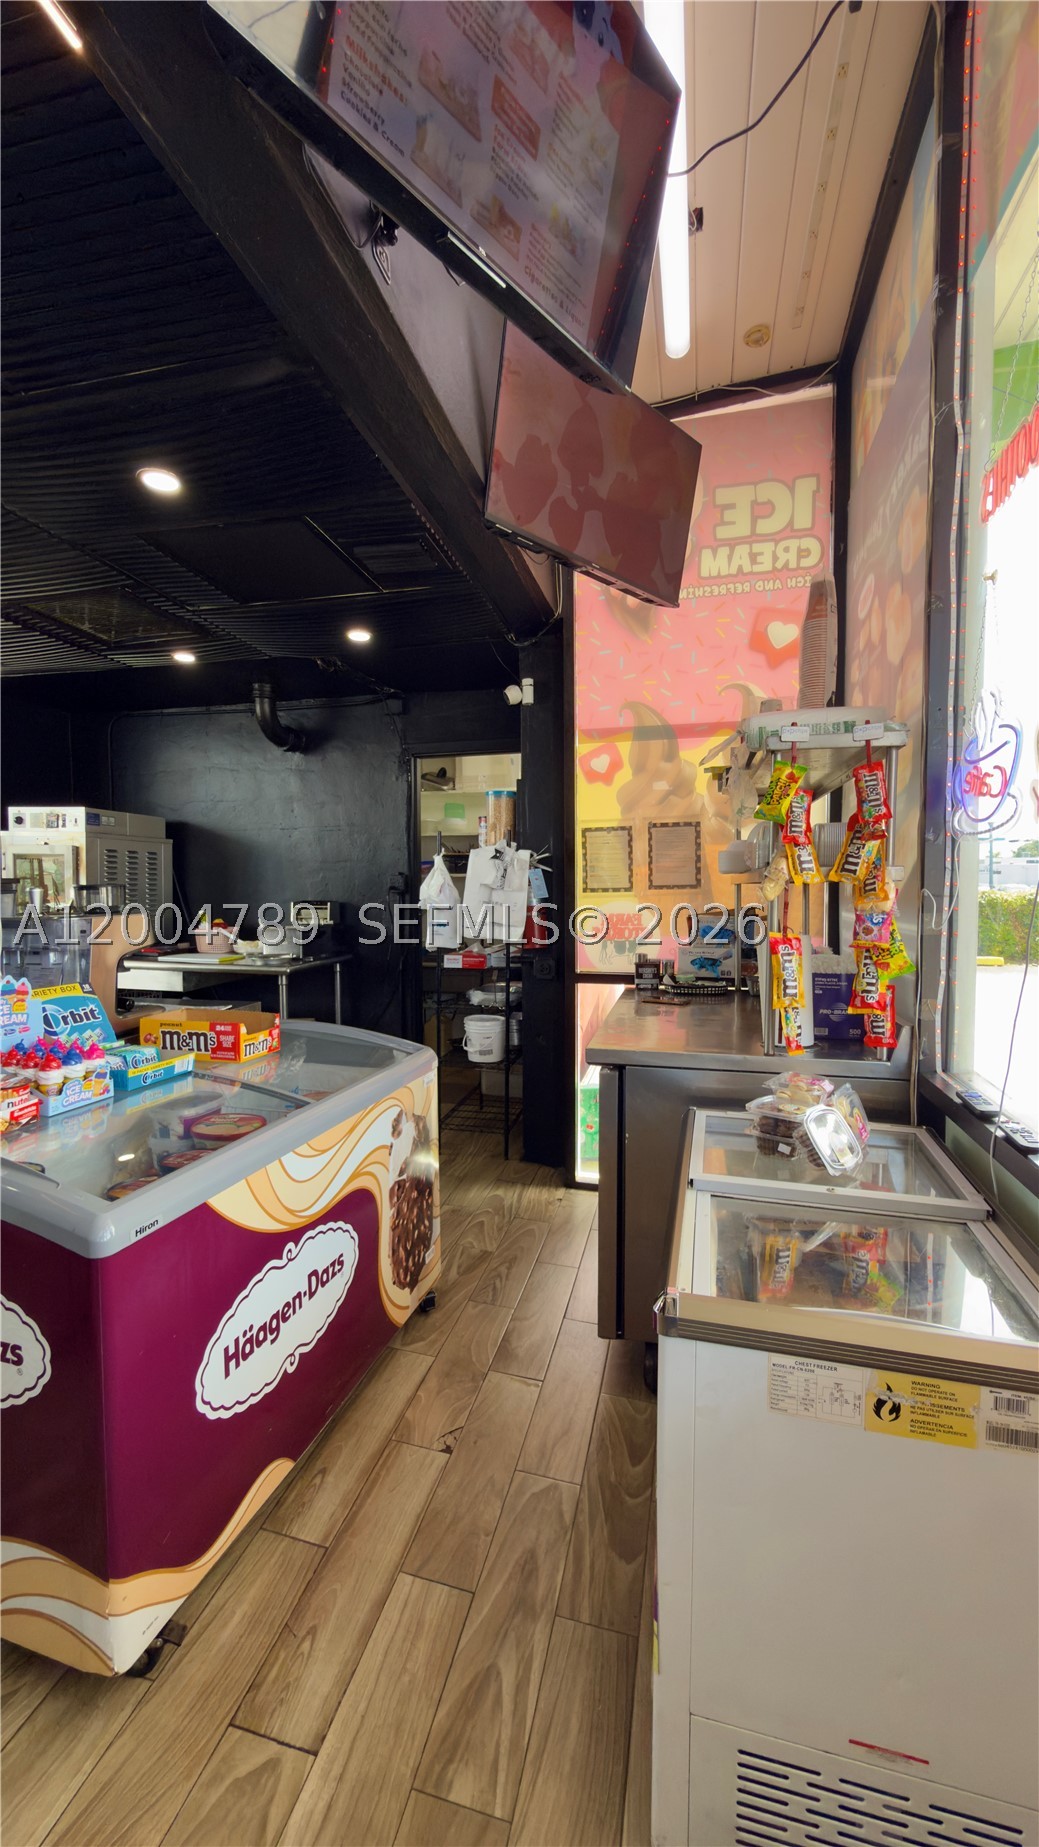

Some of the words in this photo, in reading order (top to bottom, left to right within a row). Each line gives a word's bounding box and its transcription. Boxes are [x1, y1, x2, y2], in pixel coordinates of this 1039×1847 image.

[340, 88, 371, 126] Cookies
[60, 985, 77, 993] BOX
[42, 1003, 102, 1038] Orbit
[160, 1029, 217, 1053] m&m's
[131, 1053, 158, 1069] Orbit
[142, 1070, 164, 1085] Orbit
[66, 1084, 81, 1096] ICE
[63, 1091, 93, 1106] CREAM
[135, 1218, 159, 1238] Hiron
[223, 1251, 345, 1380] Häagen-Dazs
[795, 1360, 813, 1368] CHEST
[813, 1364, 838, 1372] FREEZER
[911, 1380, 941, 1389] WARNING
[928, 1388, 948, 1396] OPERATE
[910, 1391, 937, 1399] FLAMMABLE
[910, 1418, 954, 1430] ADVERTENCIA
